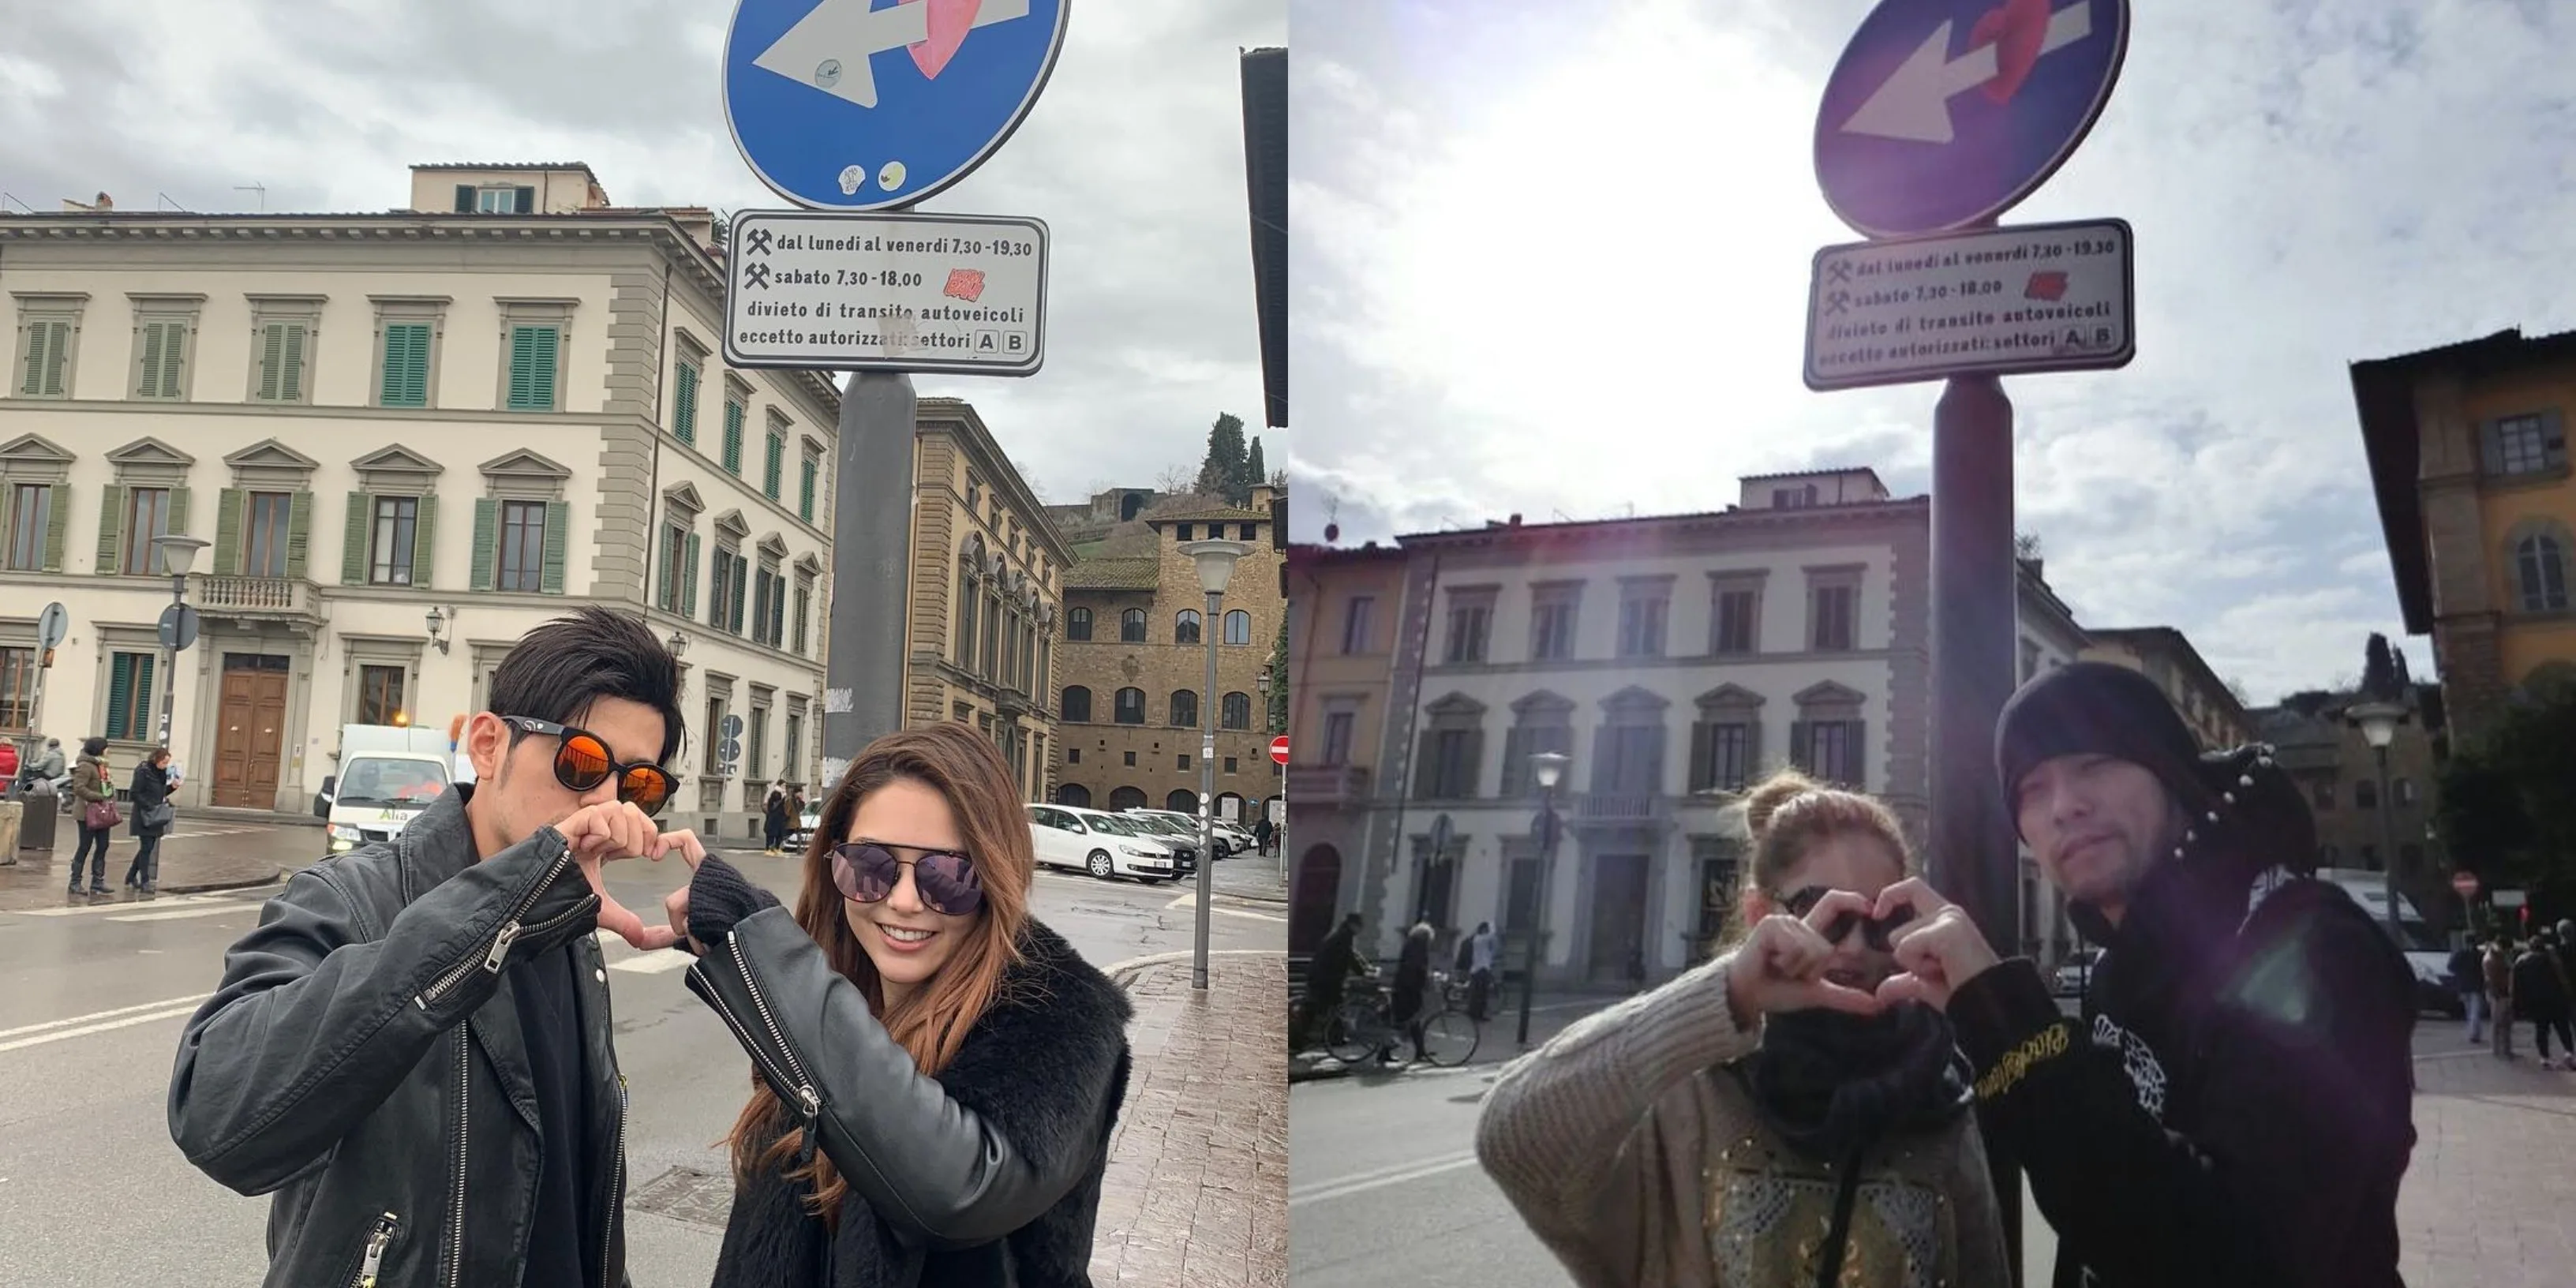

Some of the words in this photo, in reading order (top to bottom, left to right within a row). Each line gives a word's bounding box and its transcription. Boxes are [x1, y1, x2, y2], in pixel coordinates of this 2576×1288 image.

[777, 234, 803, 250] dal
[808, 234, 860, 251] lunedi
[864, 236, 882, 252] al
[886, 238, 948, 253] venerdi
[774, 268, 830, 285] sabato
[747, 301, 807, 316] divieto
[815, 301, 831, 317] di
[839, 303, 914, 320] transito
[921, 305, 1024, 323] autoveicoli
[739, 328, 803, 344] eccetto
[911, 332, 971, 349] settori
[979, 334, 994, 350] A
[1008, 335, 1022, 350] B
[2065, 329, 2080, 344] A
